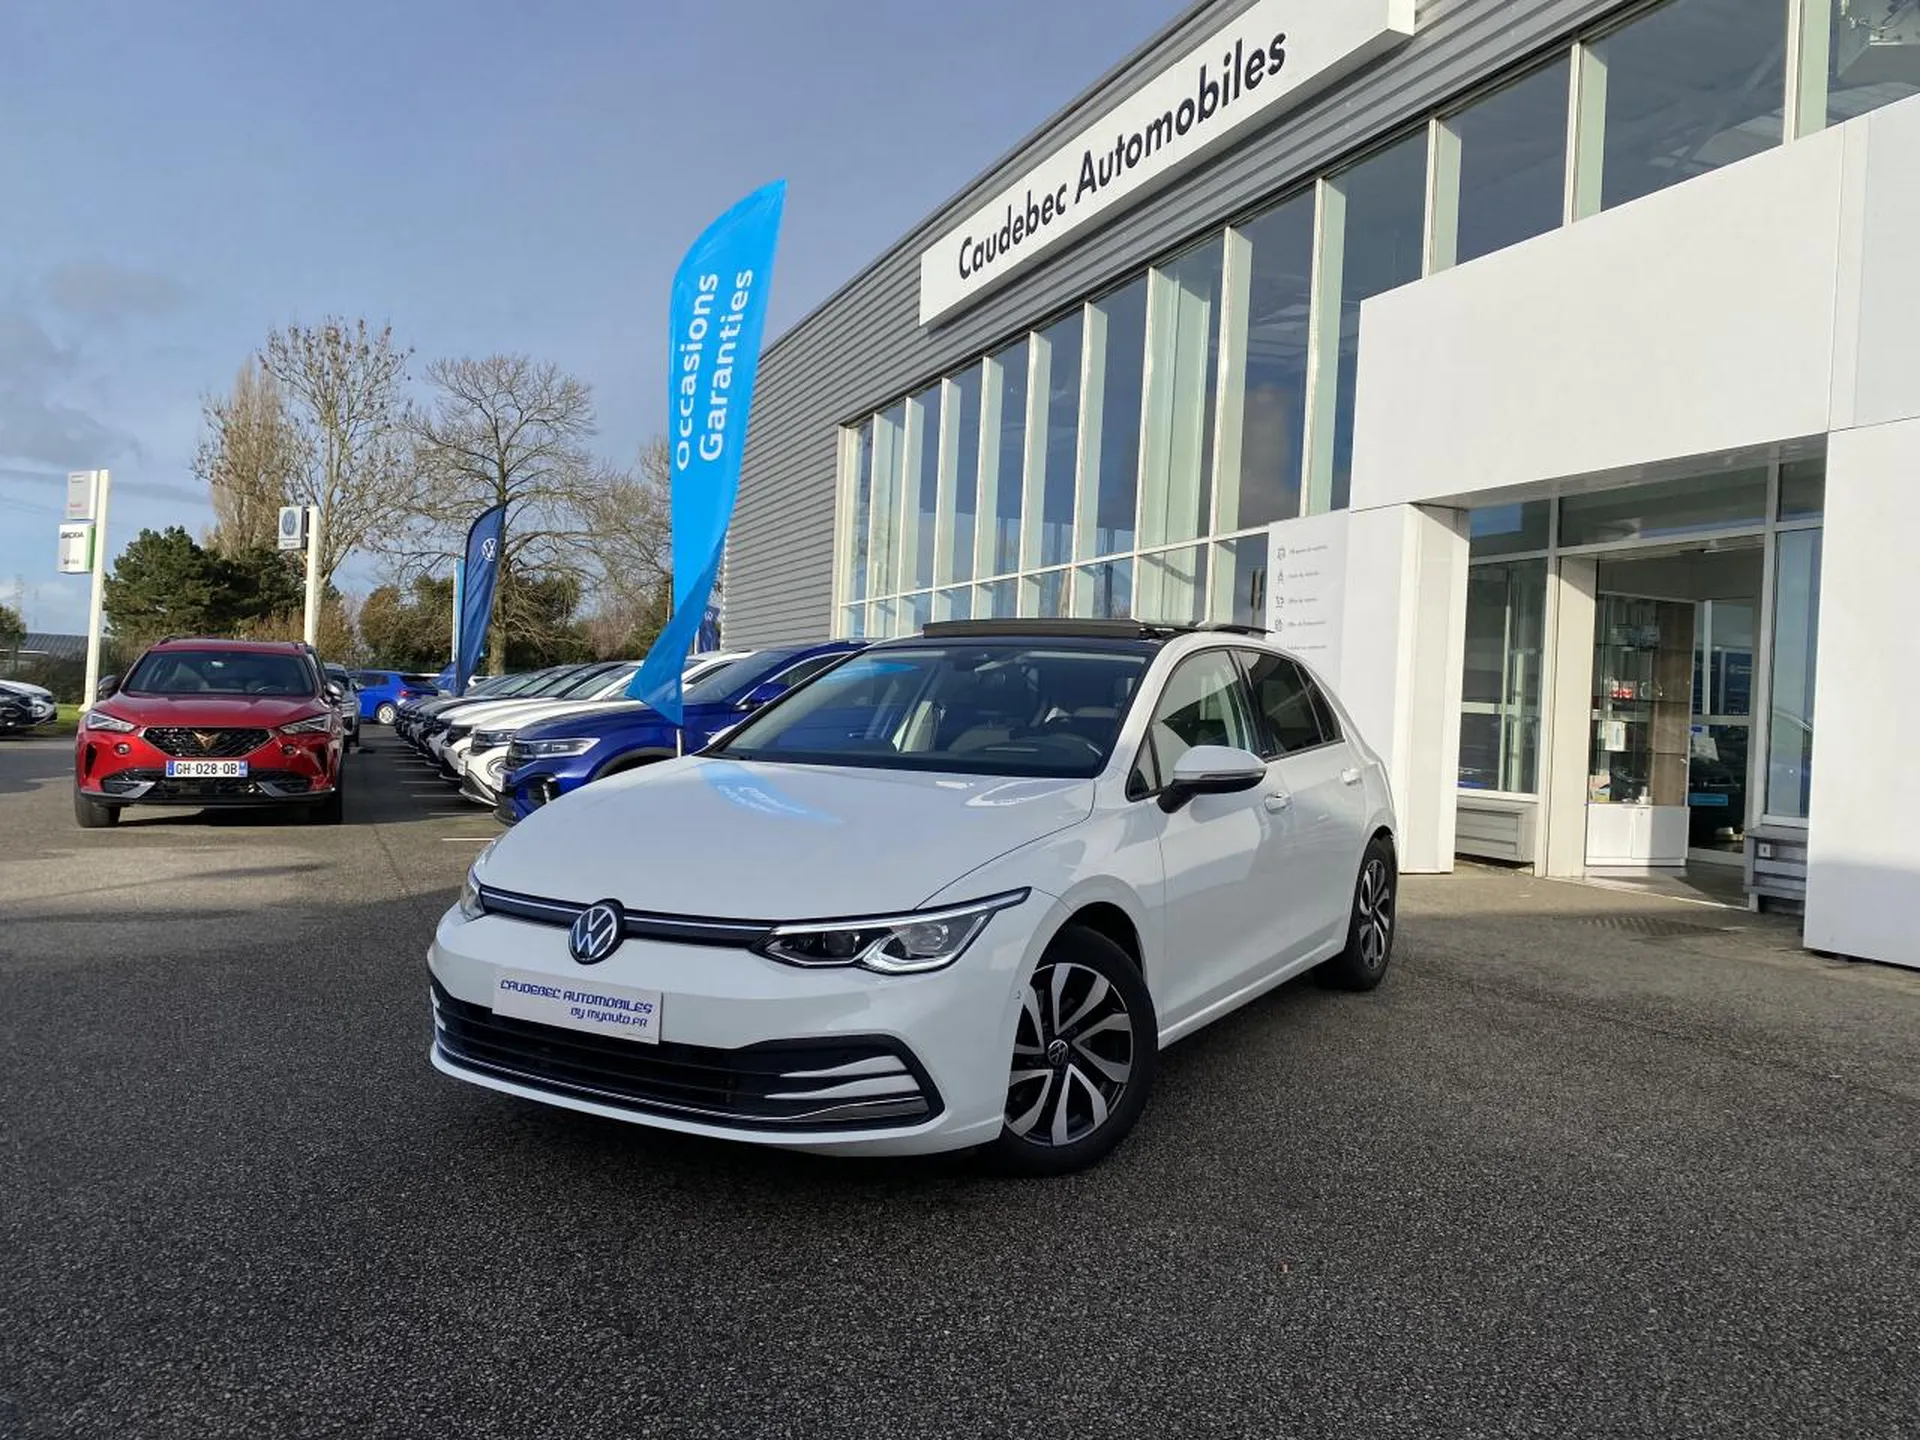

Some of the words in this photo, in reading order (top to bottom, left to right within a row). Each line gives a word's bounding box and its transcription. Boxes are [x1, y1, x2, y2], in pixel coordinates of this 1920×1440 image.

[958, 181, 1068, 281] Caudebec
[1074, 31, 1287, 205] Automobiles
[699, 269, 753, 461] Garanties
[500, 979, 561, 999] CAUDEBEC
[563, 990, 653, 1014] AUTOMOBILES
